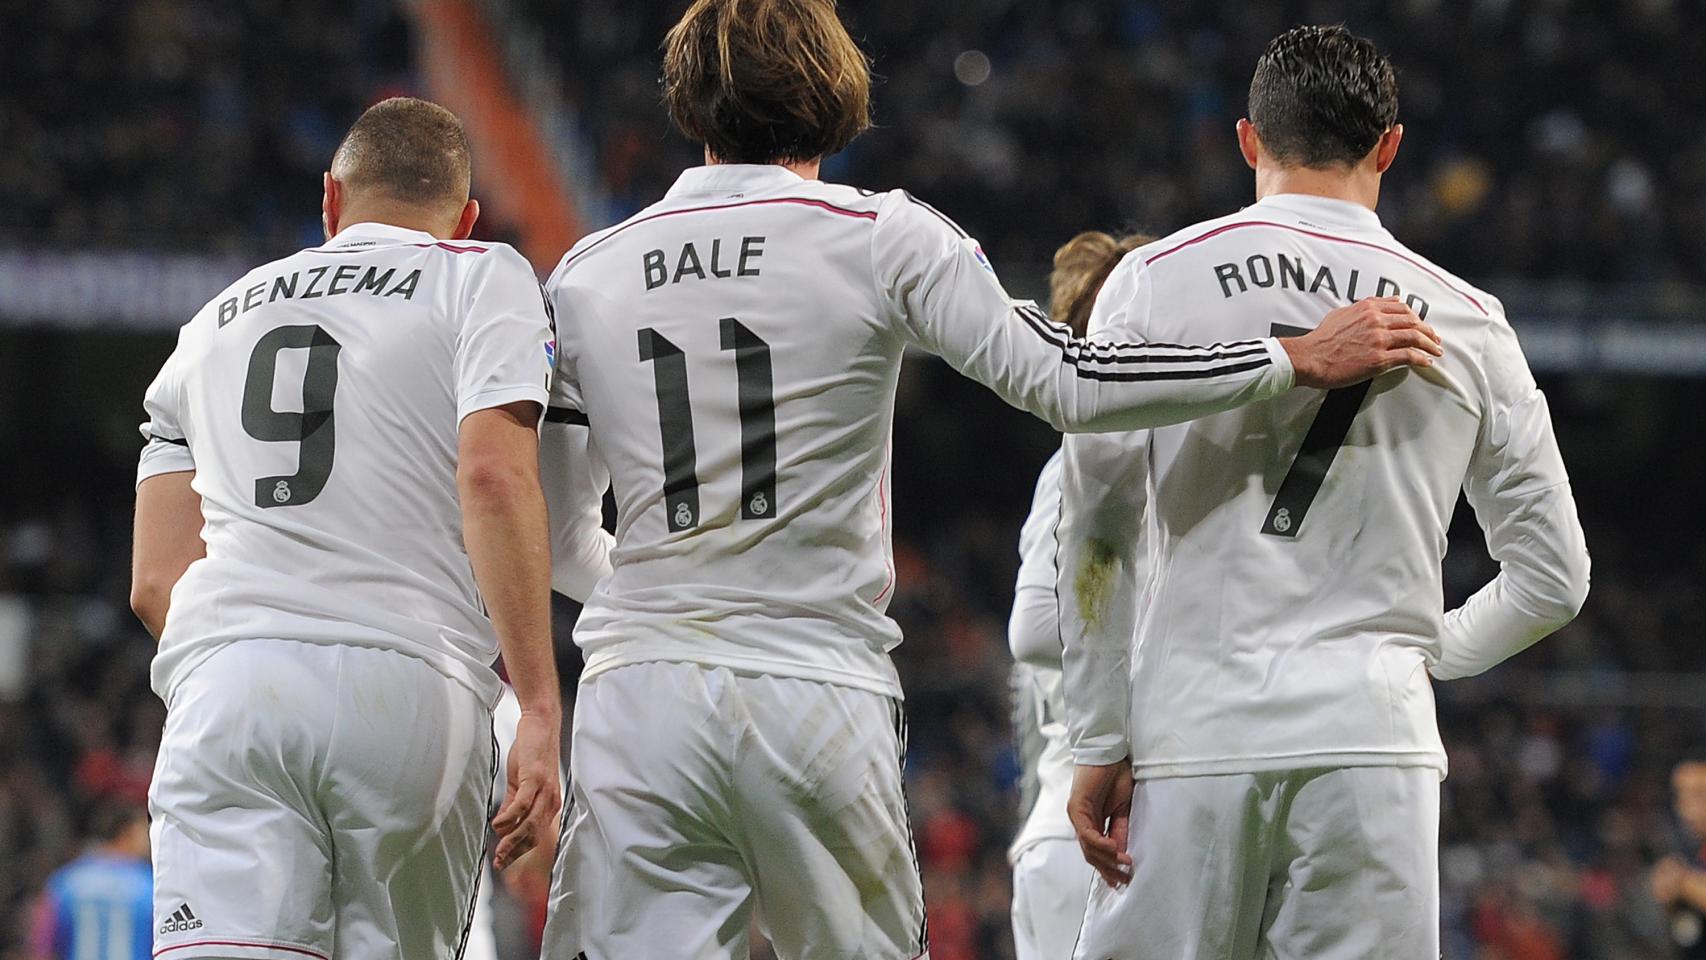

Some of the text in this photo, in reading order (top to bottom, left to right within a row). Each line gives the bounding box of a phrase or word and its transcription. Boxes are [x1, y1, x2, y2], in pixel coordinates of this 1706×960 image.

[218, 265, 423, 329] BENZEMA
[643, 236, 766, 291] BALE
[241, 324, 342, 509] 9
[637, 317, 776, 533] 11
[1260, 322, 1373, 537] 7
[160, 919, 203, 934] adidas
